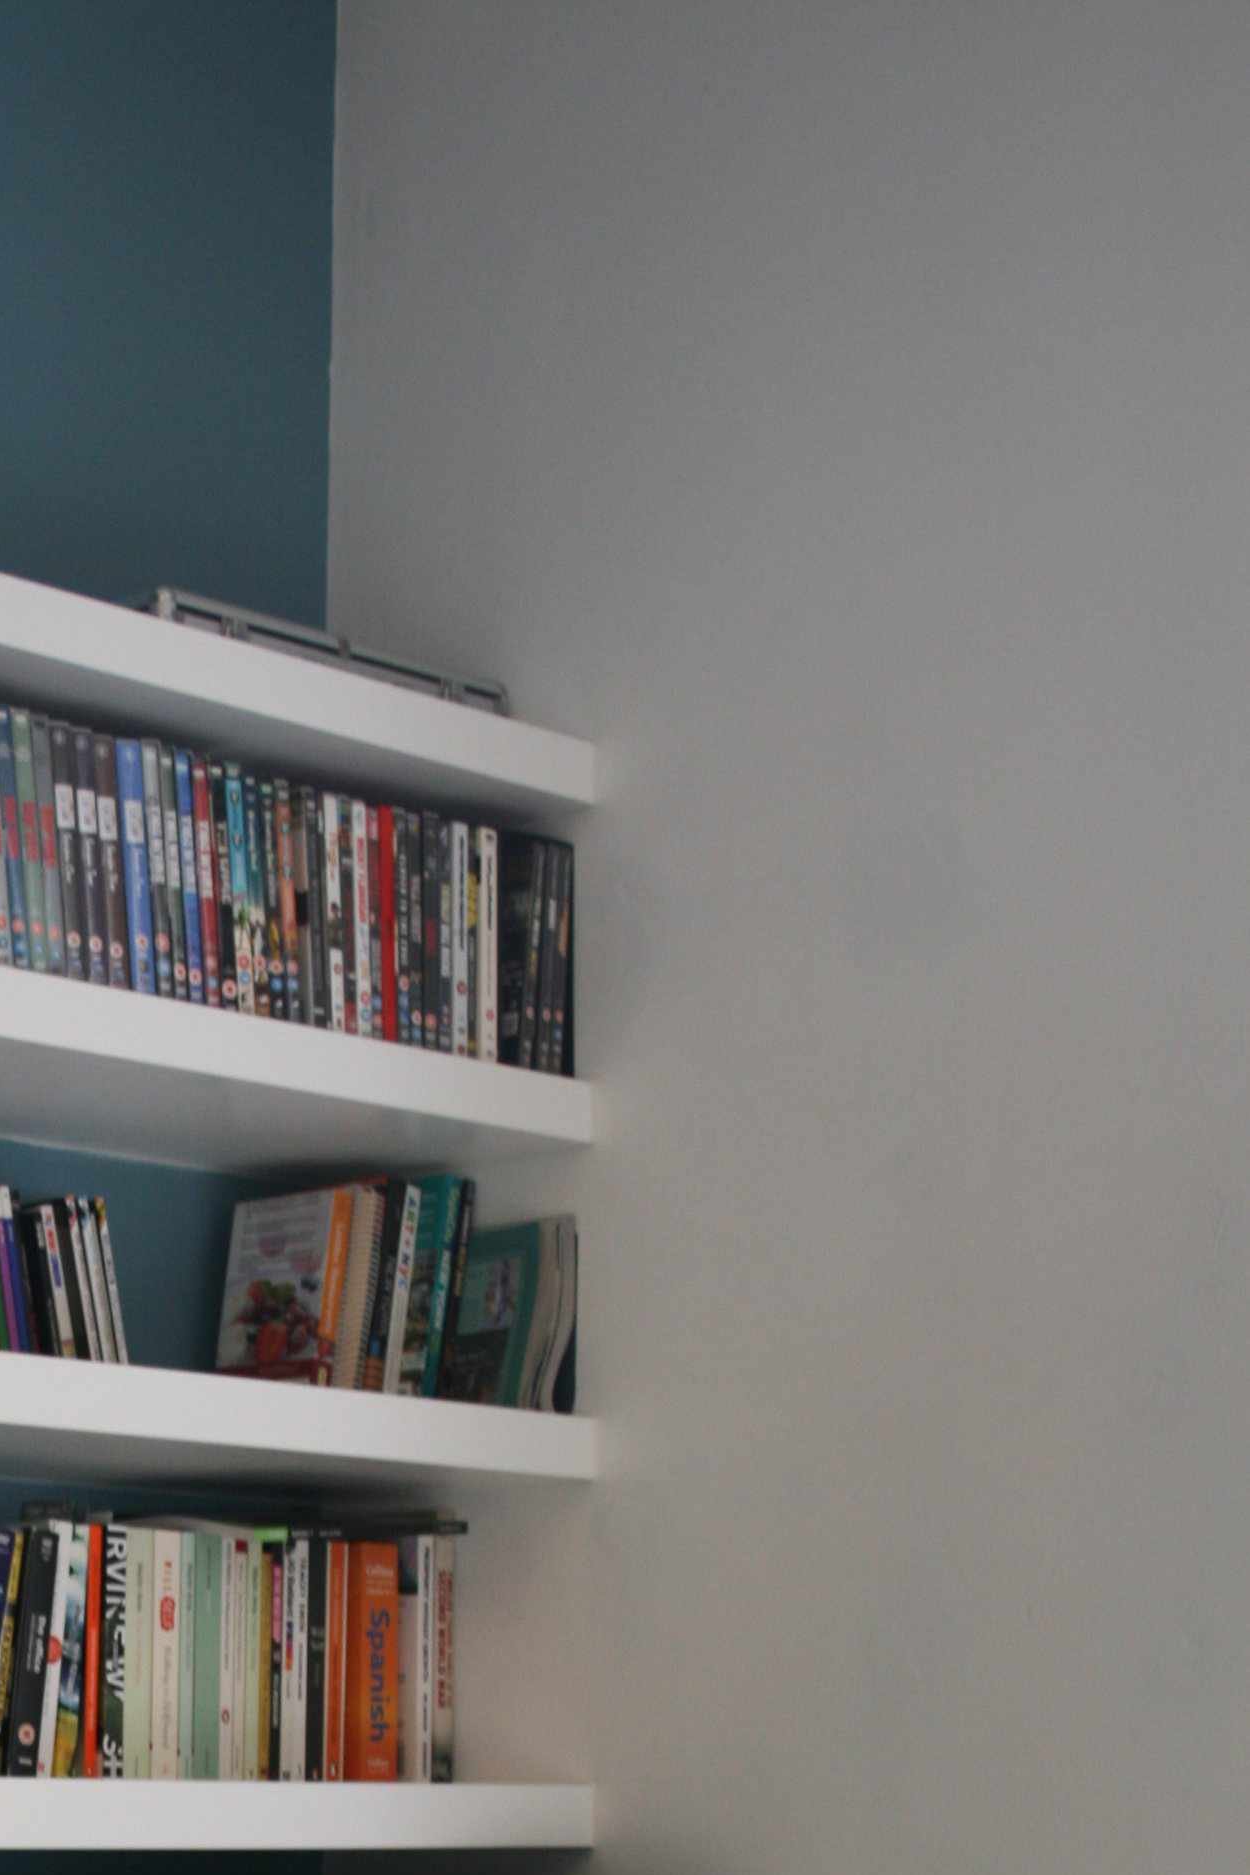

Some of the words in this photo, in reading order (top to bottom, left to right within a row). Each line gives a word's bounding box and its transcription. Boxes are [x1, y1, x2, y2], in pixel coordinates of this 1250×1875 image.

[438, 1570, 447, 1625] SECOND
[35, 1614, 46, 1634] the
[32, 1637, 44, 1674] office
[437, 1629, 446, 1676] WORLD
[365, 1608, 391, 1742] Spanish
[437, 1680, 446, 1710] WAR
